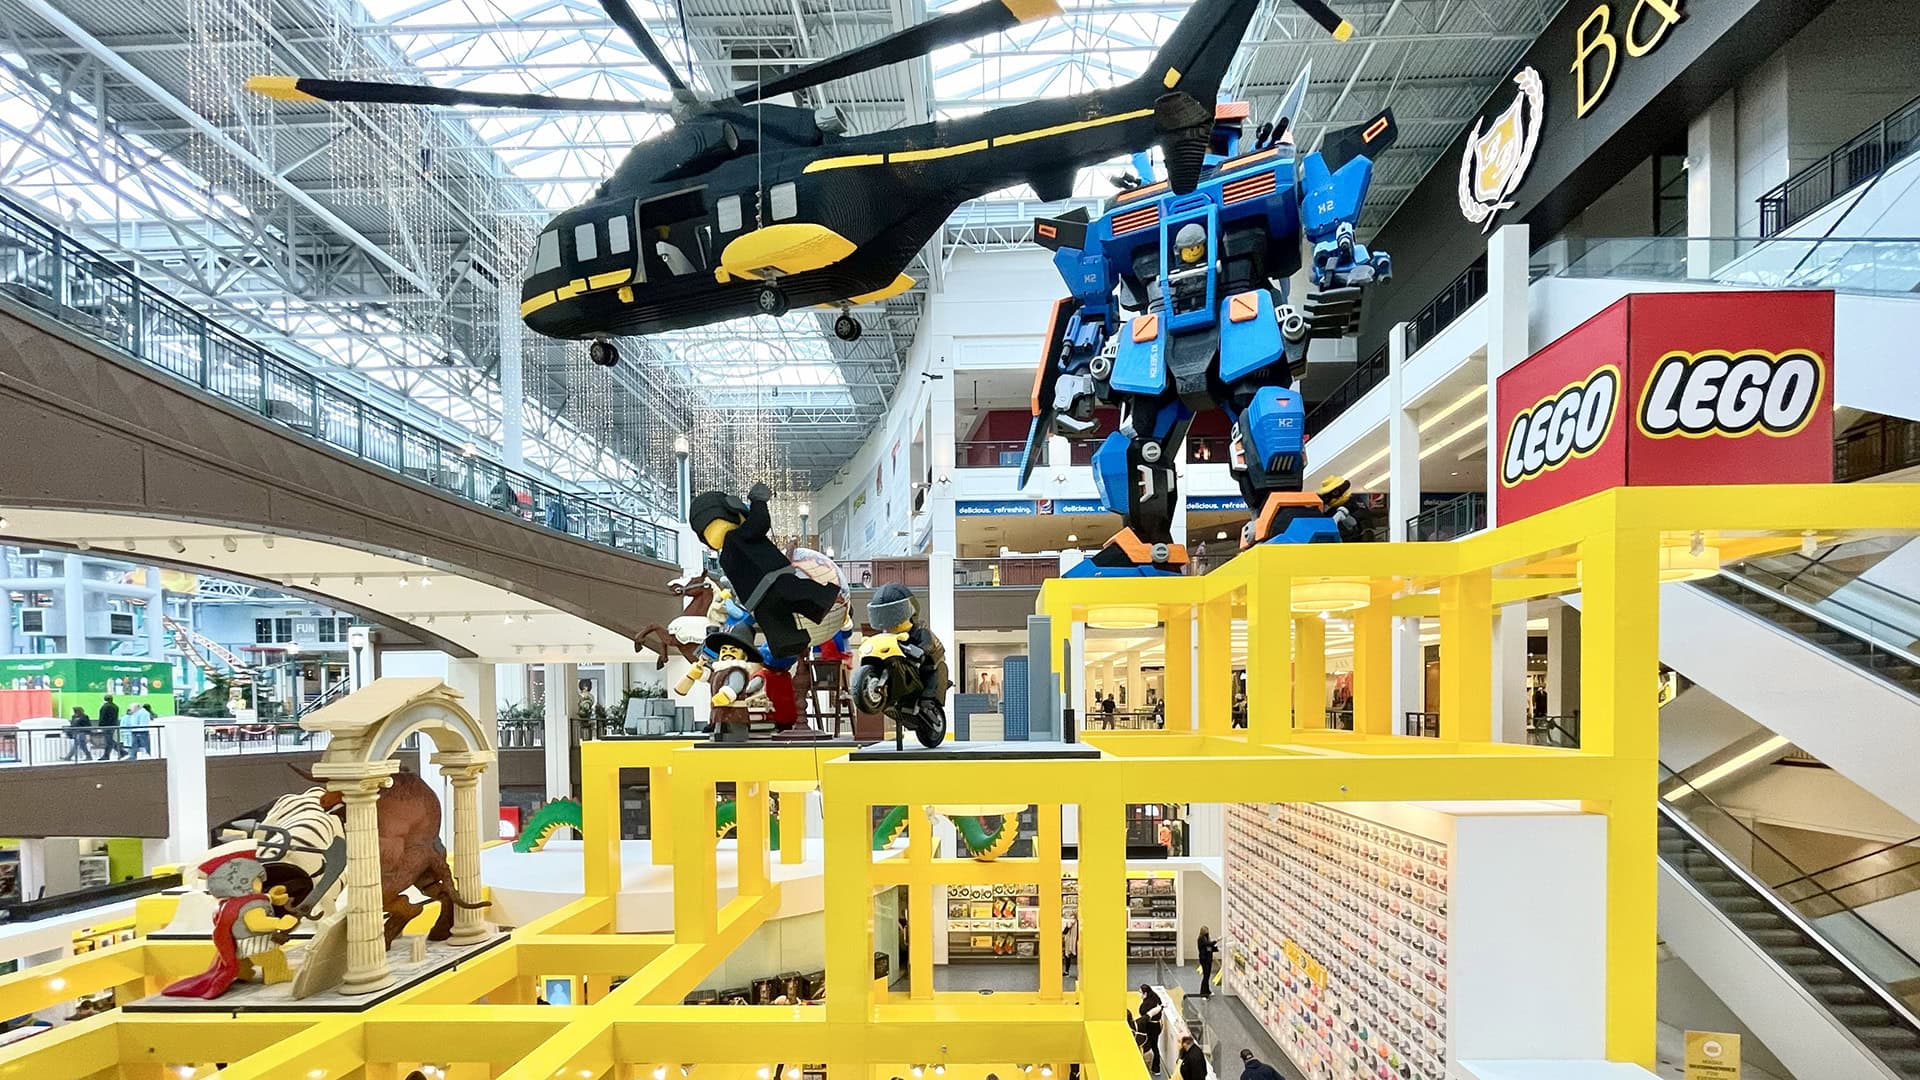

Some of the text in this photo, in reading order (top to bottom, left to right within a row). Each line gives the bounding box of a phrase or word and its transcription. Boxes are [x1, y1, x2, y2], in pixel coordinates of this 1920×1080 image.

[1640, 354, 1821, 434] LEGO
[1504, 369, 1618, 484] LEGO
[958, 505, 992, 514] delicious.
[993, 505, 1032, 514] refreshing.
[296, 623, 315, 633] FUN
